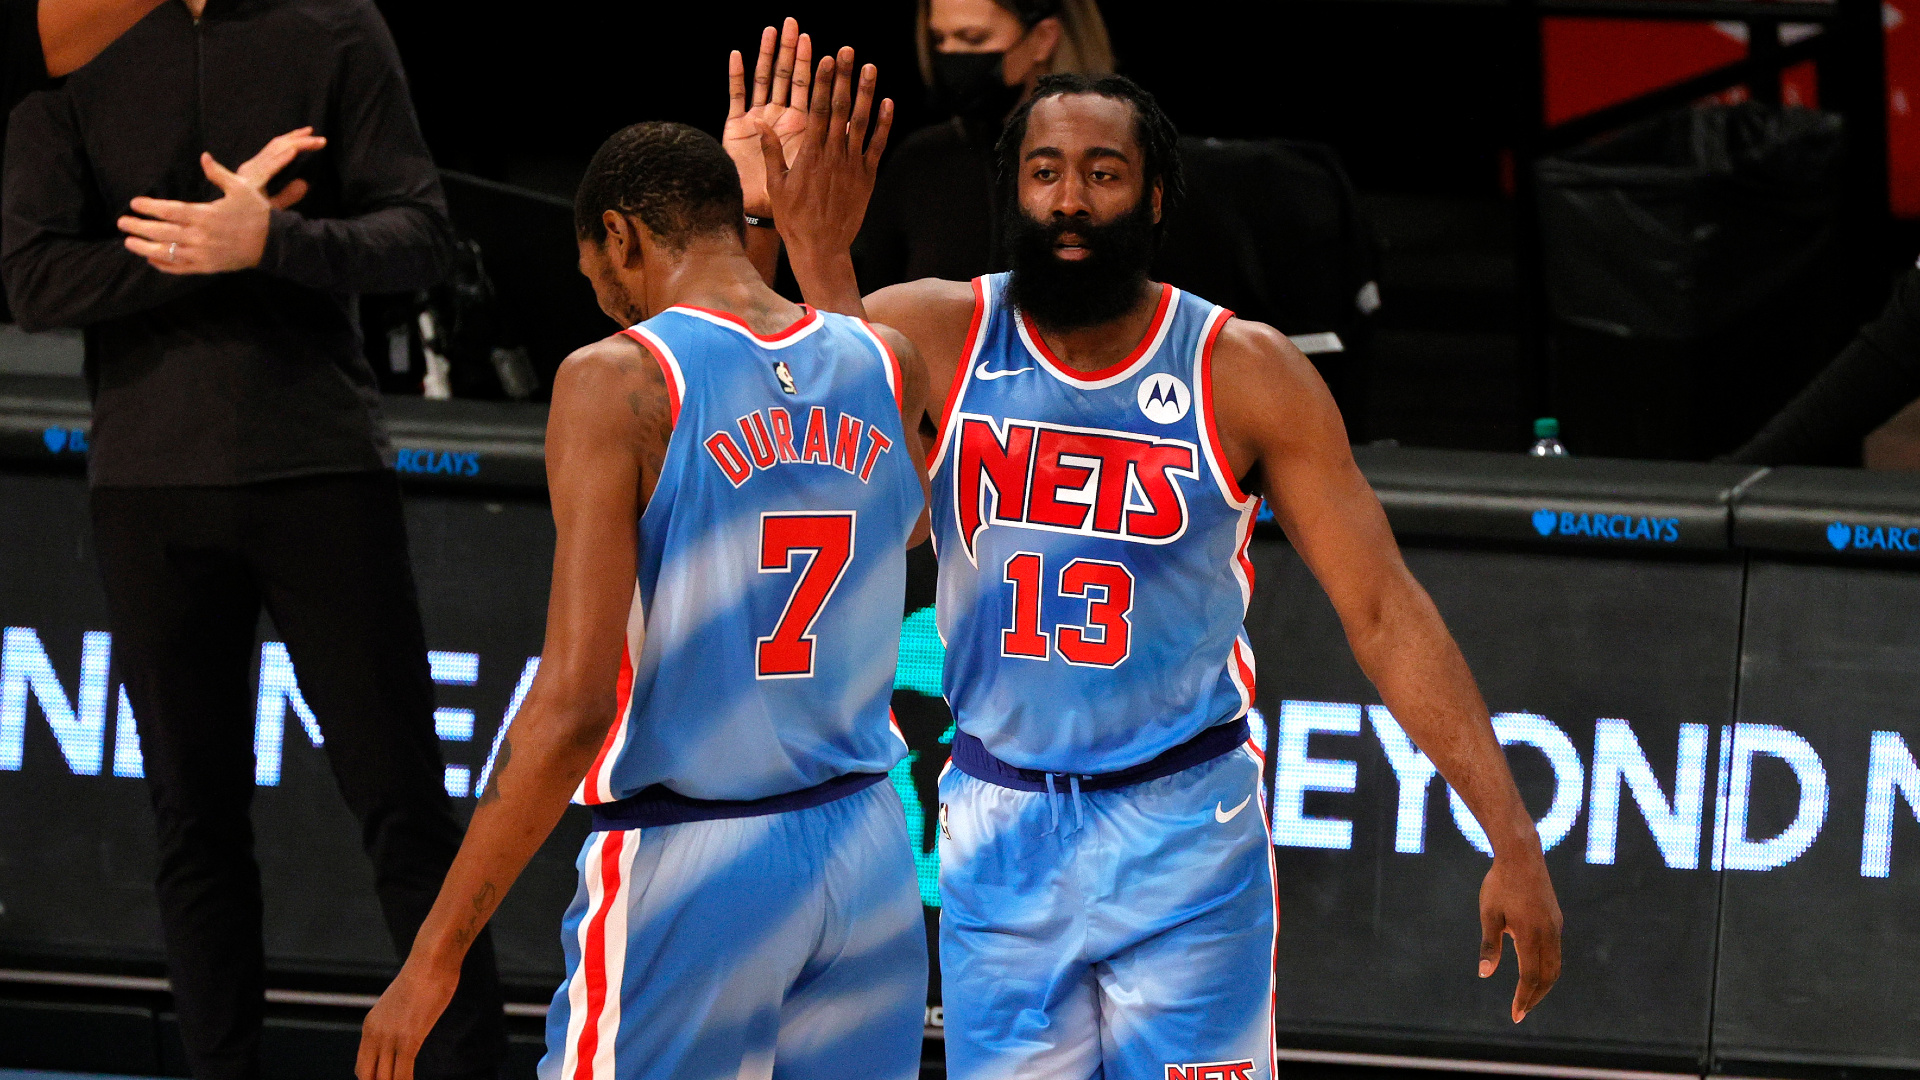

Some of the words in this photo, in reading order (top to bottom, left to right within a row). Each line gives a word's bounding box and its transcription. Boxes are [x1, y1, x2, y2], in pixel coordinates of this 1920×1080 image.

[395, 448, 480, 476] RCLAYS
[703, 406, 893, 489] DURANT
[953, 412, 1199, 570] NETS
[1559, 511, 1680, 542] BARCLAYS
[1854, 524, 1920, 552] BARC
[755, 510, 857, 680] 7
[1000, 550, 1135, 669] 13
[1248, 700, 1829, 871] EYOND
